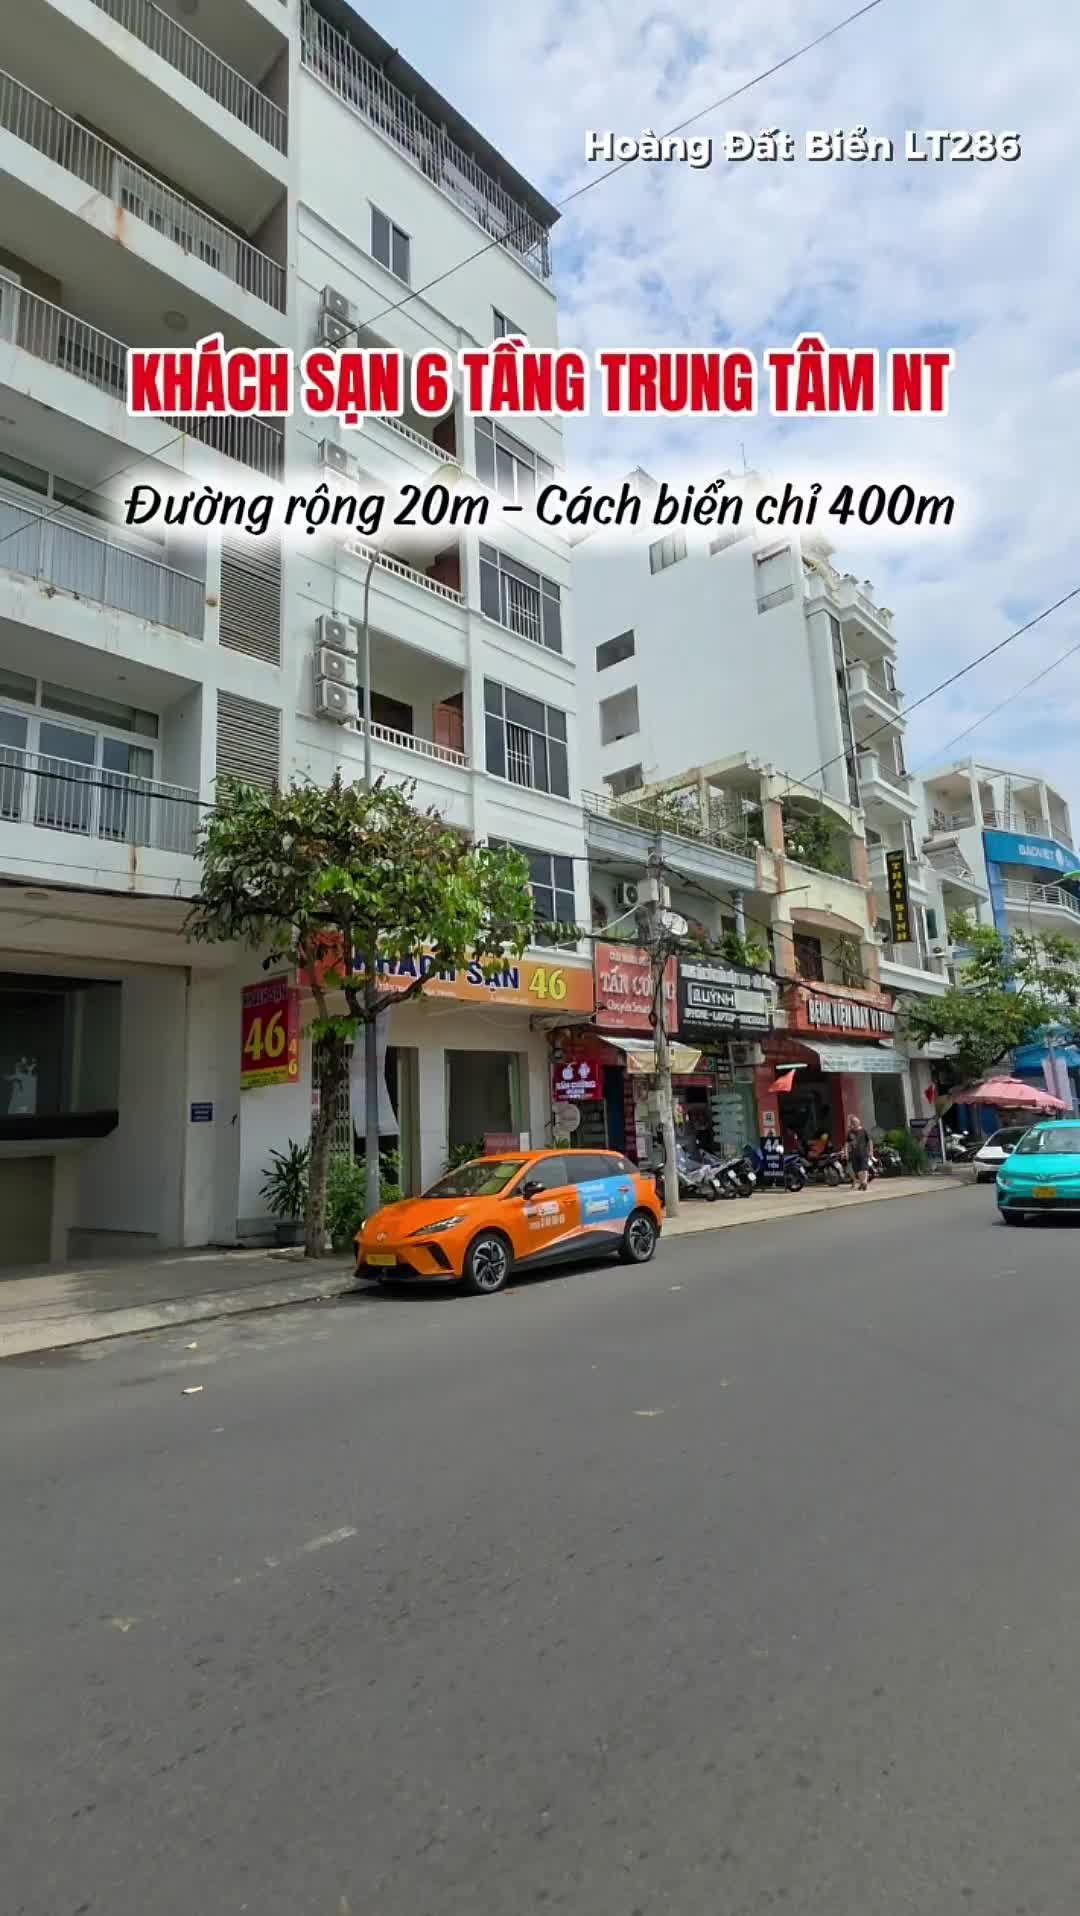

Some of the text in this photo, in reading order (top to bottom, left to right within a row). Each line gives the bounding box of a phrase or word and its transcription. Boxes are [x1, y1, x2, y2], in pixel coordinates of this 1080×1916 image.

[467, 960, 520, 992] SẠN
[528, 966, 568, 1000] 46
[244, 1009, 286, 1061] 46
